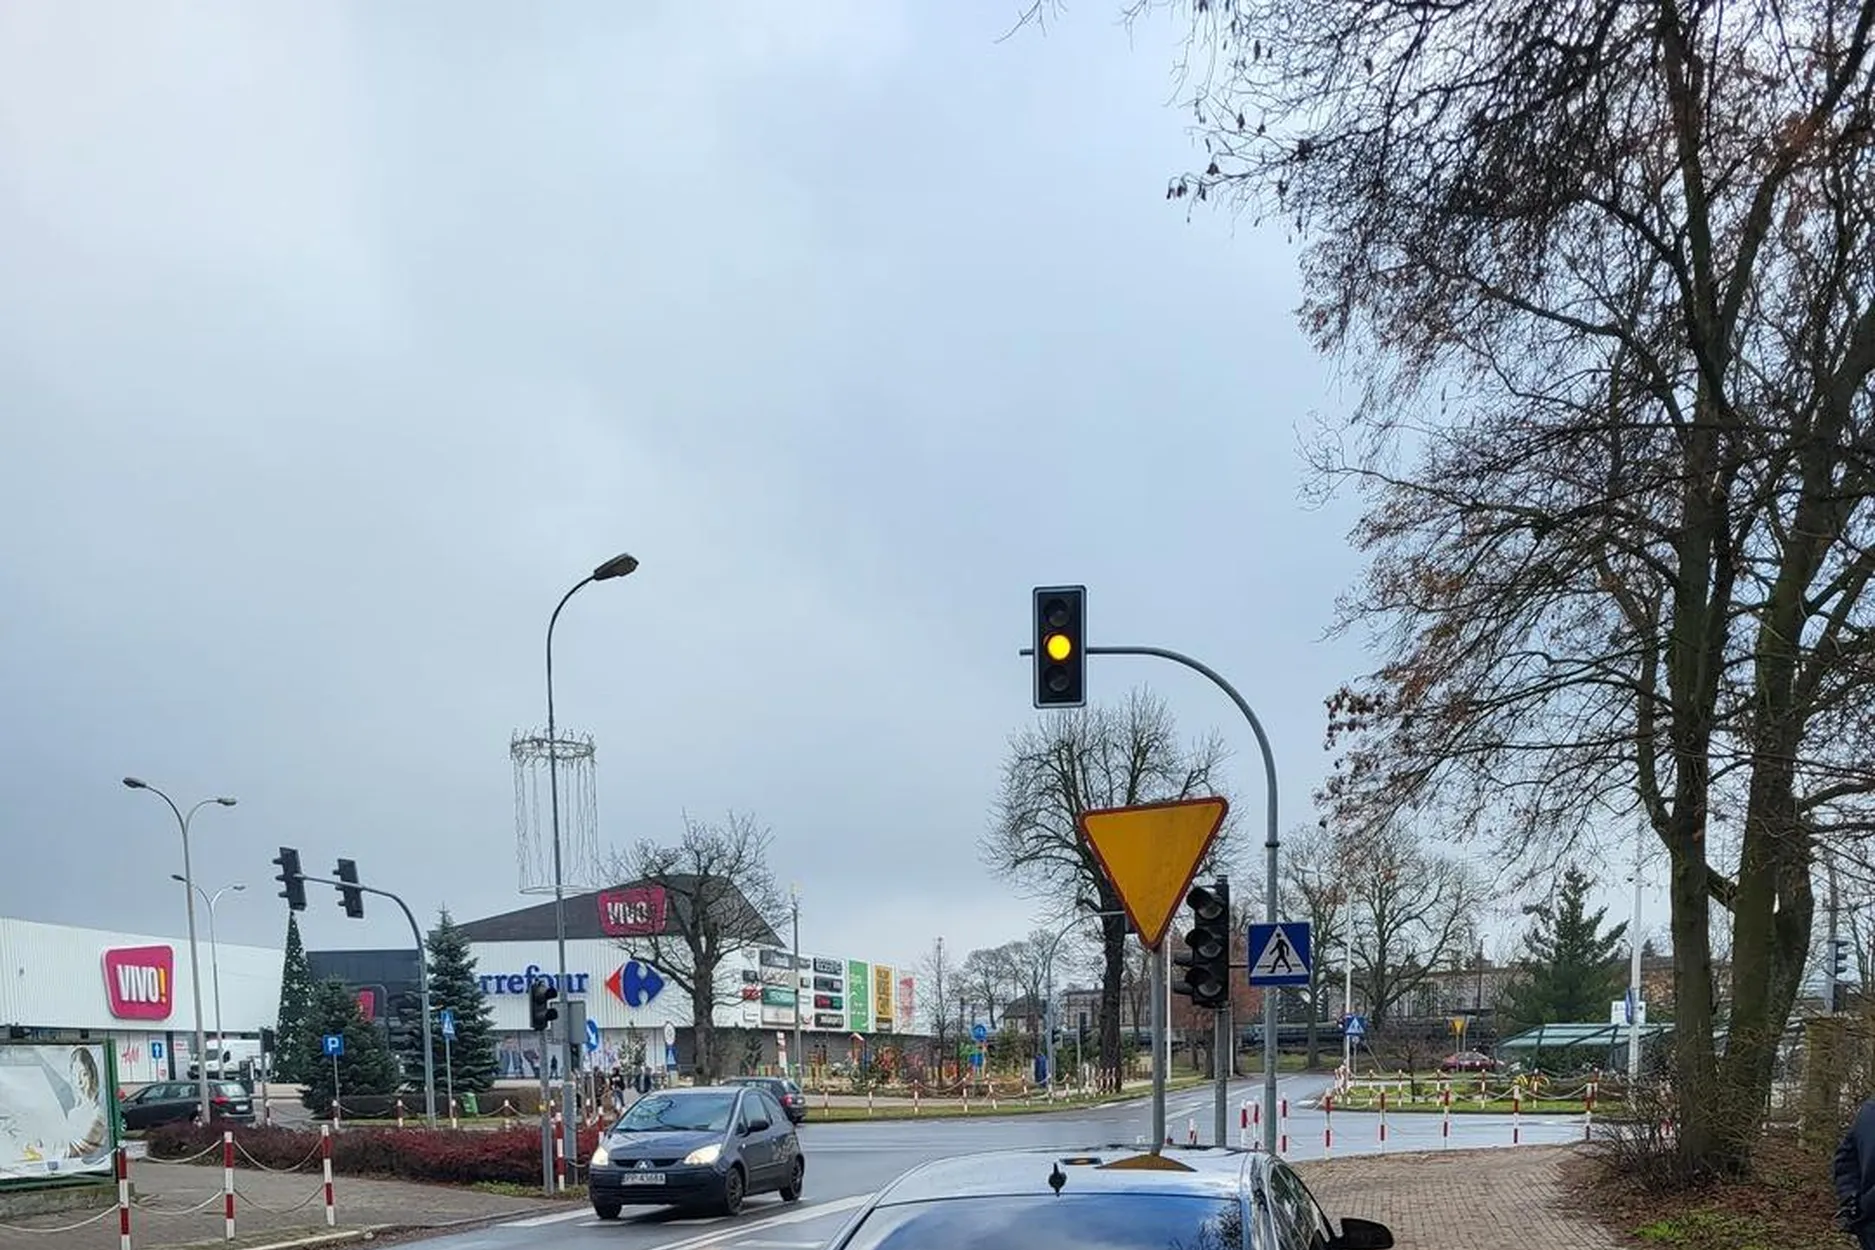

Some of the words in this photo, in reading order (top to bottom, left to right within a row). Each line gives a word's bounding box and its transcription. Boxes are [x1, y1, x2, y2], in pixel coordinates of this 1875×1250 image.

[607, 901, 656, 925] VIVO
[116, 963, 168, 1004] VIVO!
[479, 964, 589, 995] rrefour
[327, 1036, 340, 1053] P
